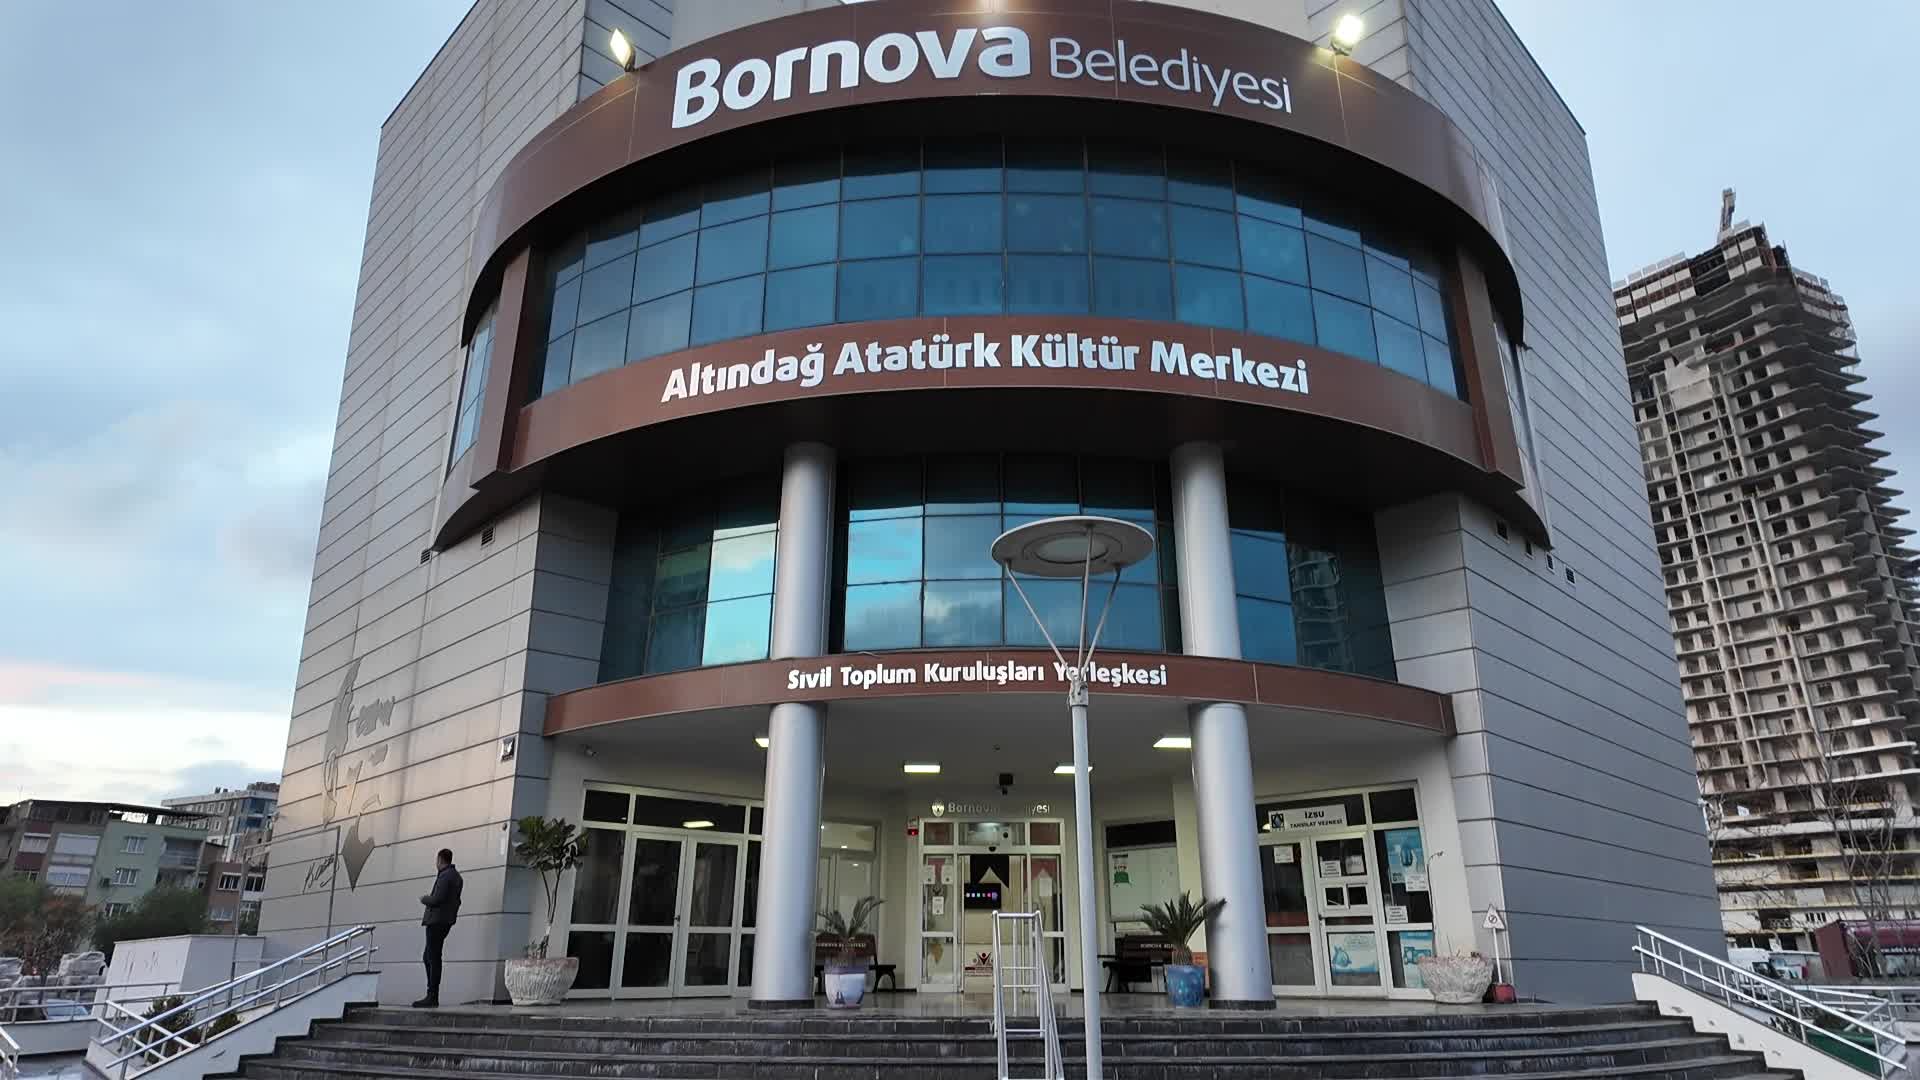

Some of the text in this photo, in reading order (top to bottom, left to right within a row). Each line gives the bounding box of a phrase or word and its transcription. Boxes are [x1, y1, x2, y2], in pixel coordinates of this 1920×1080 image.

[671, 26, 1292, 129] Bornova Belediyesi
[660, 332, 1309, 402] Altındağ Atatürk Kültür Merkezi
[840, 663, 917, 690] Toplum
[924, 660, 1045, 685] Kuruluşları
